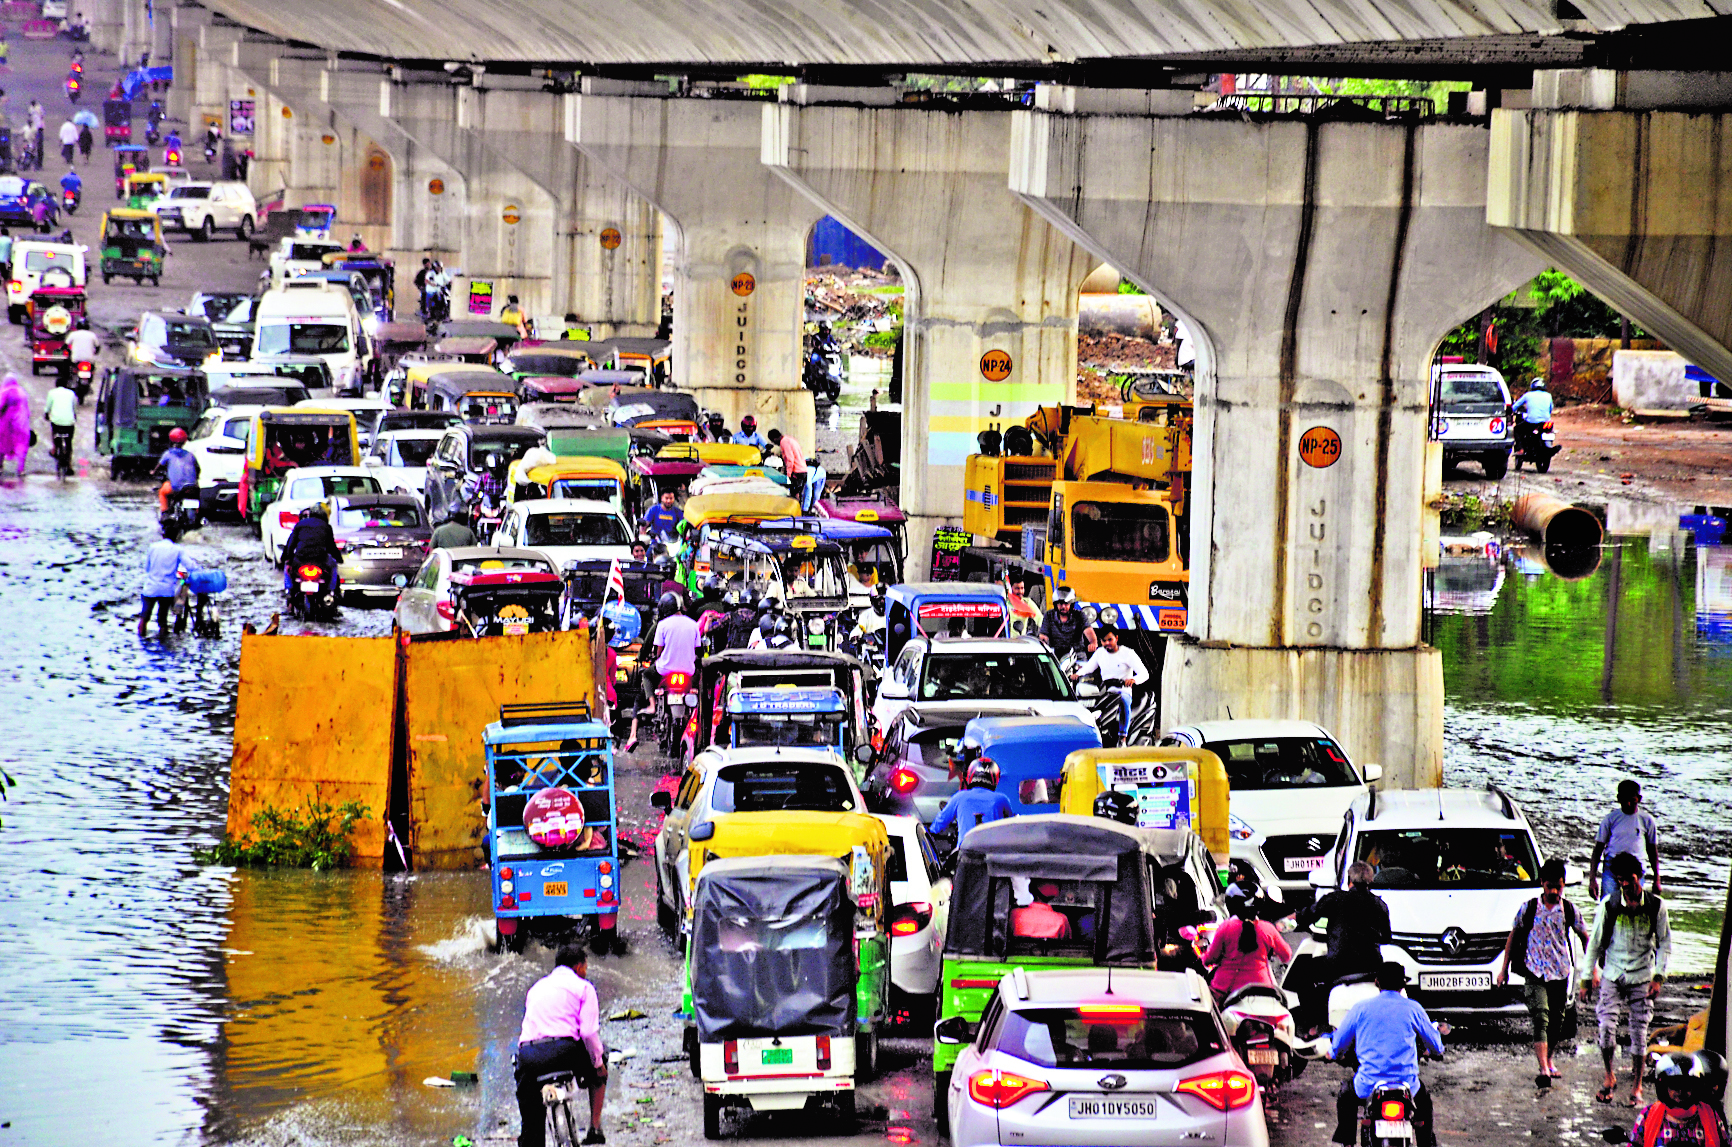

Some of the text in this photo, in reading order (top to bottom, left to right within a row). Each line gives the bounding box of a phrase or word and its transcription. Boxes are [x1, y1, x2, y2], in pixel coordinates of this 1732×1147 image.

[732, 280, 755, 291] NP-23
[735, 302, 748, 384] JUIDCO
[982, 359, 1011, 373] NP-24
[1302, 437, 1338, 455] NP-25
[1306, 499, 1326, 638] JUIDCO
[492, 615, 535, 625] MAYURI
[1160, 619, 1185, 627] 5033
[1427, 977, 1491, 989] JH02BF3033
[1077, 1102, 1154, 1115] JH01DV5050
